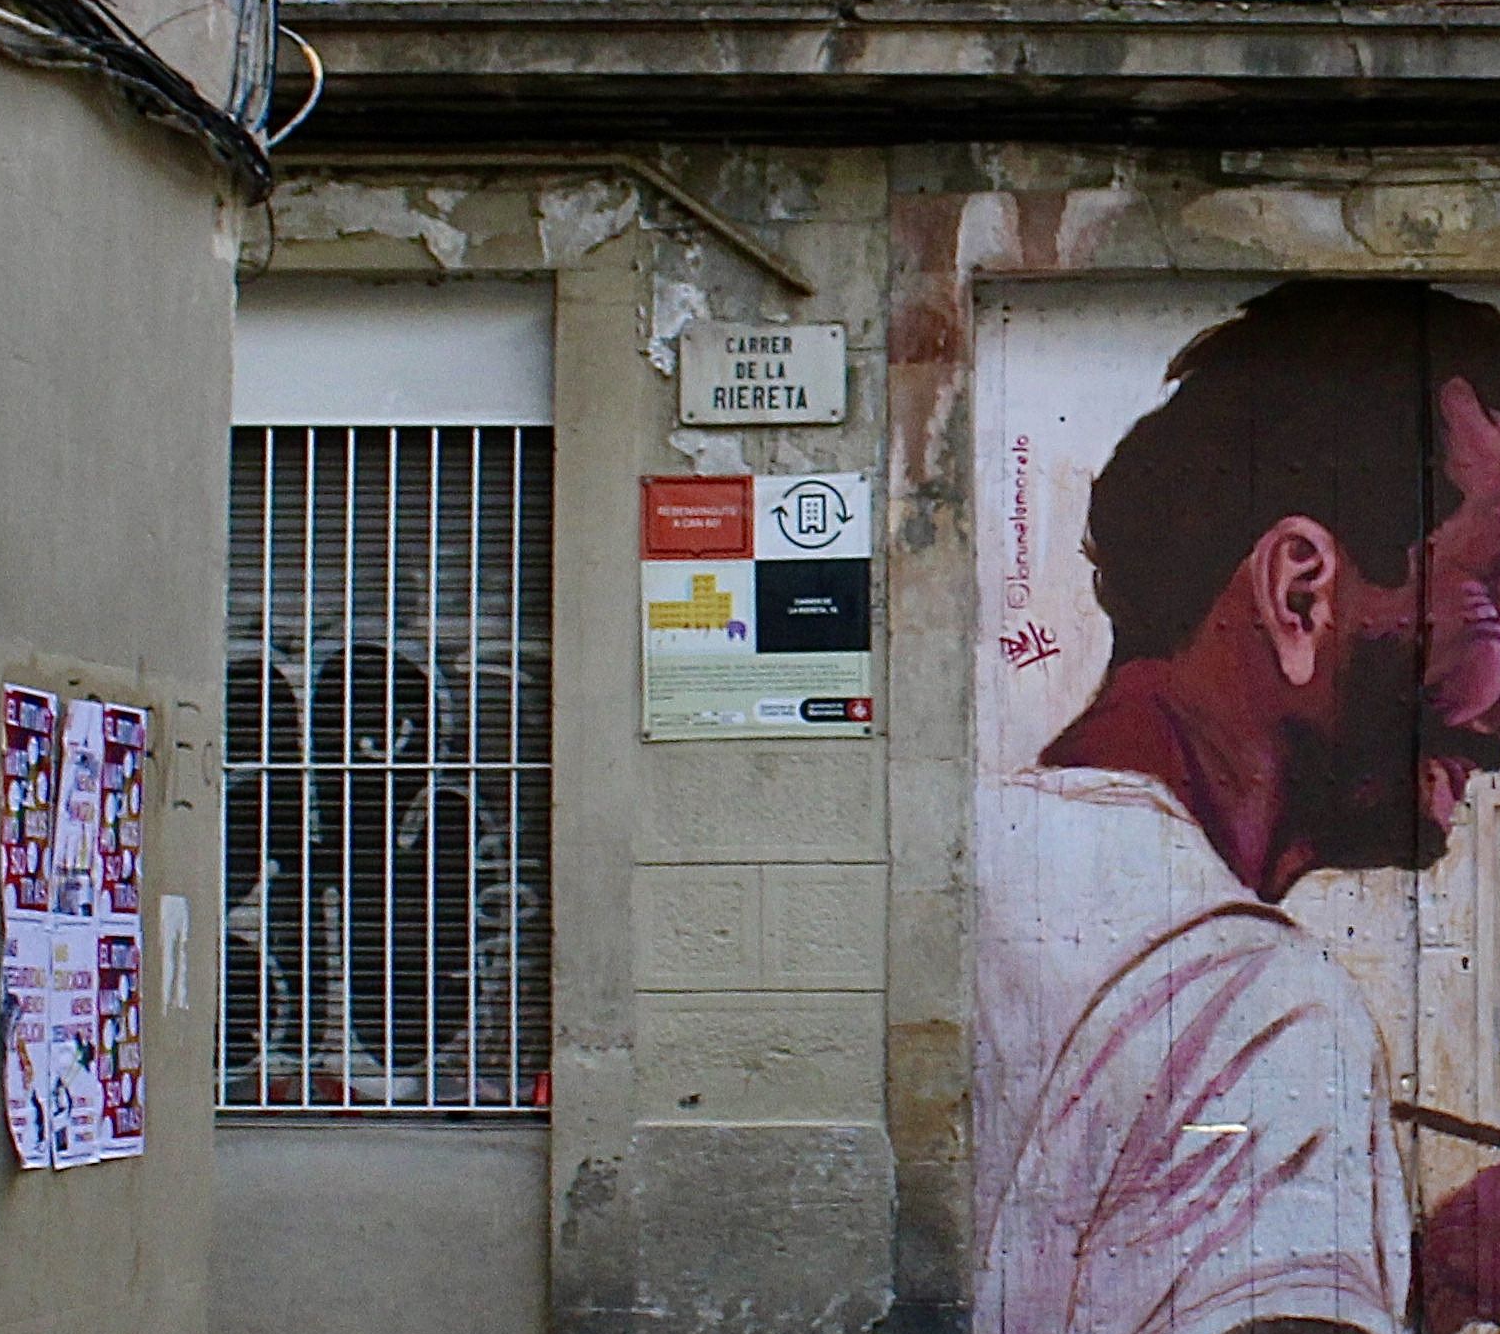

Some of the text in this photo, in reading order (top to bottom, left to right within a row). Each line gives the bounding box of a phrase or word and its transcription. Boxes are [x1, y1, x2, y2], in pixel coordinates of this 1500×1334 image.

[725, 336, 792, 355] CARRER
[735, 361, 786, 380] DE LA
[712, 386, 809, 411] RIERETA
